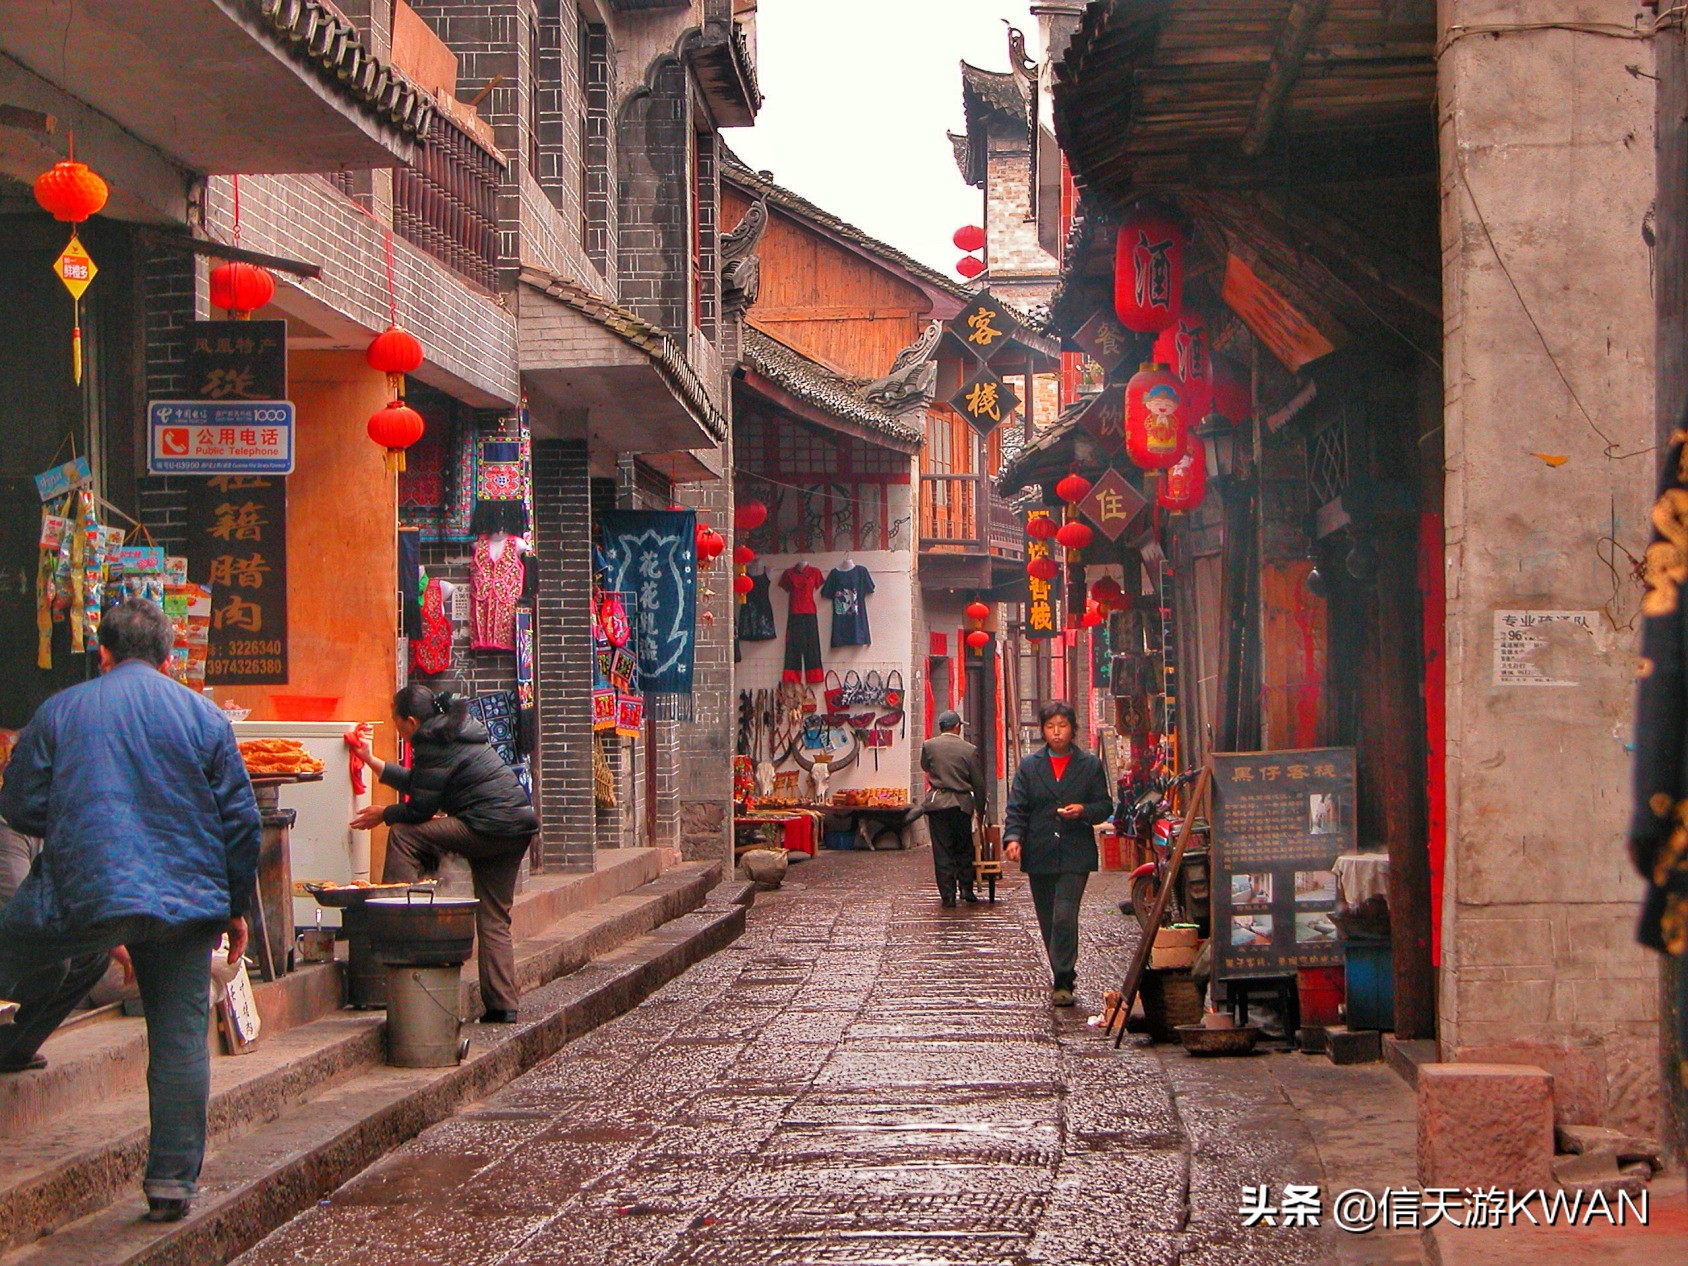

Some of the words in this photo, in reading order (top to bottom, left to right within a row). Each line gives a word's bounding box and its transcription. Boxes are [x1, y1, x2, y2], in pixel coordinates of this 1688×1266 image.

[254, 409, 287, 421] 1000
[196, 428, 279, 446] 公用电话
[195, 446, 224, 456] Public
[230, 446, 279, 457] Telephone
[229, 640, 281, 656] 3226340
